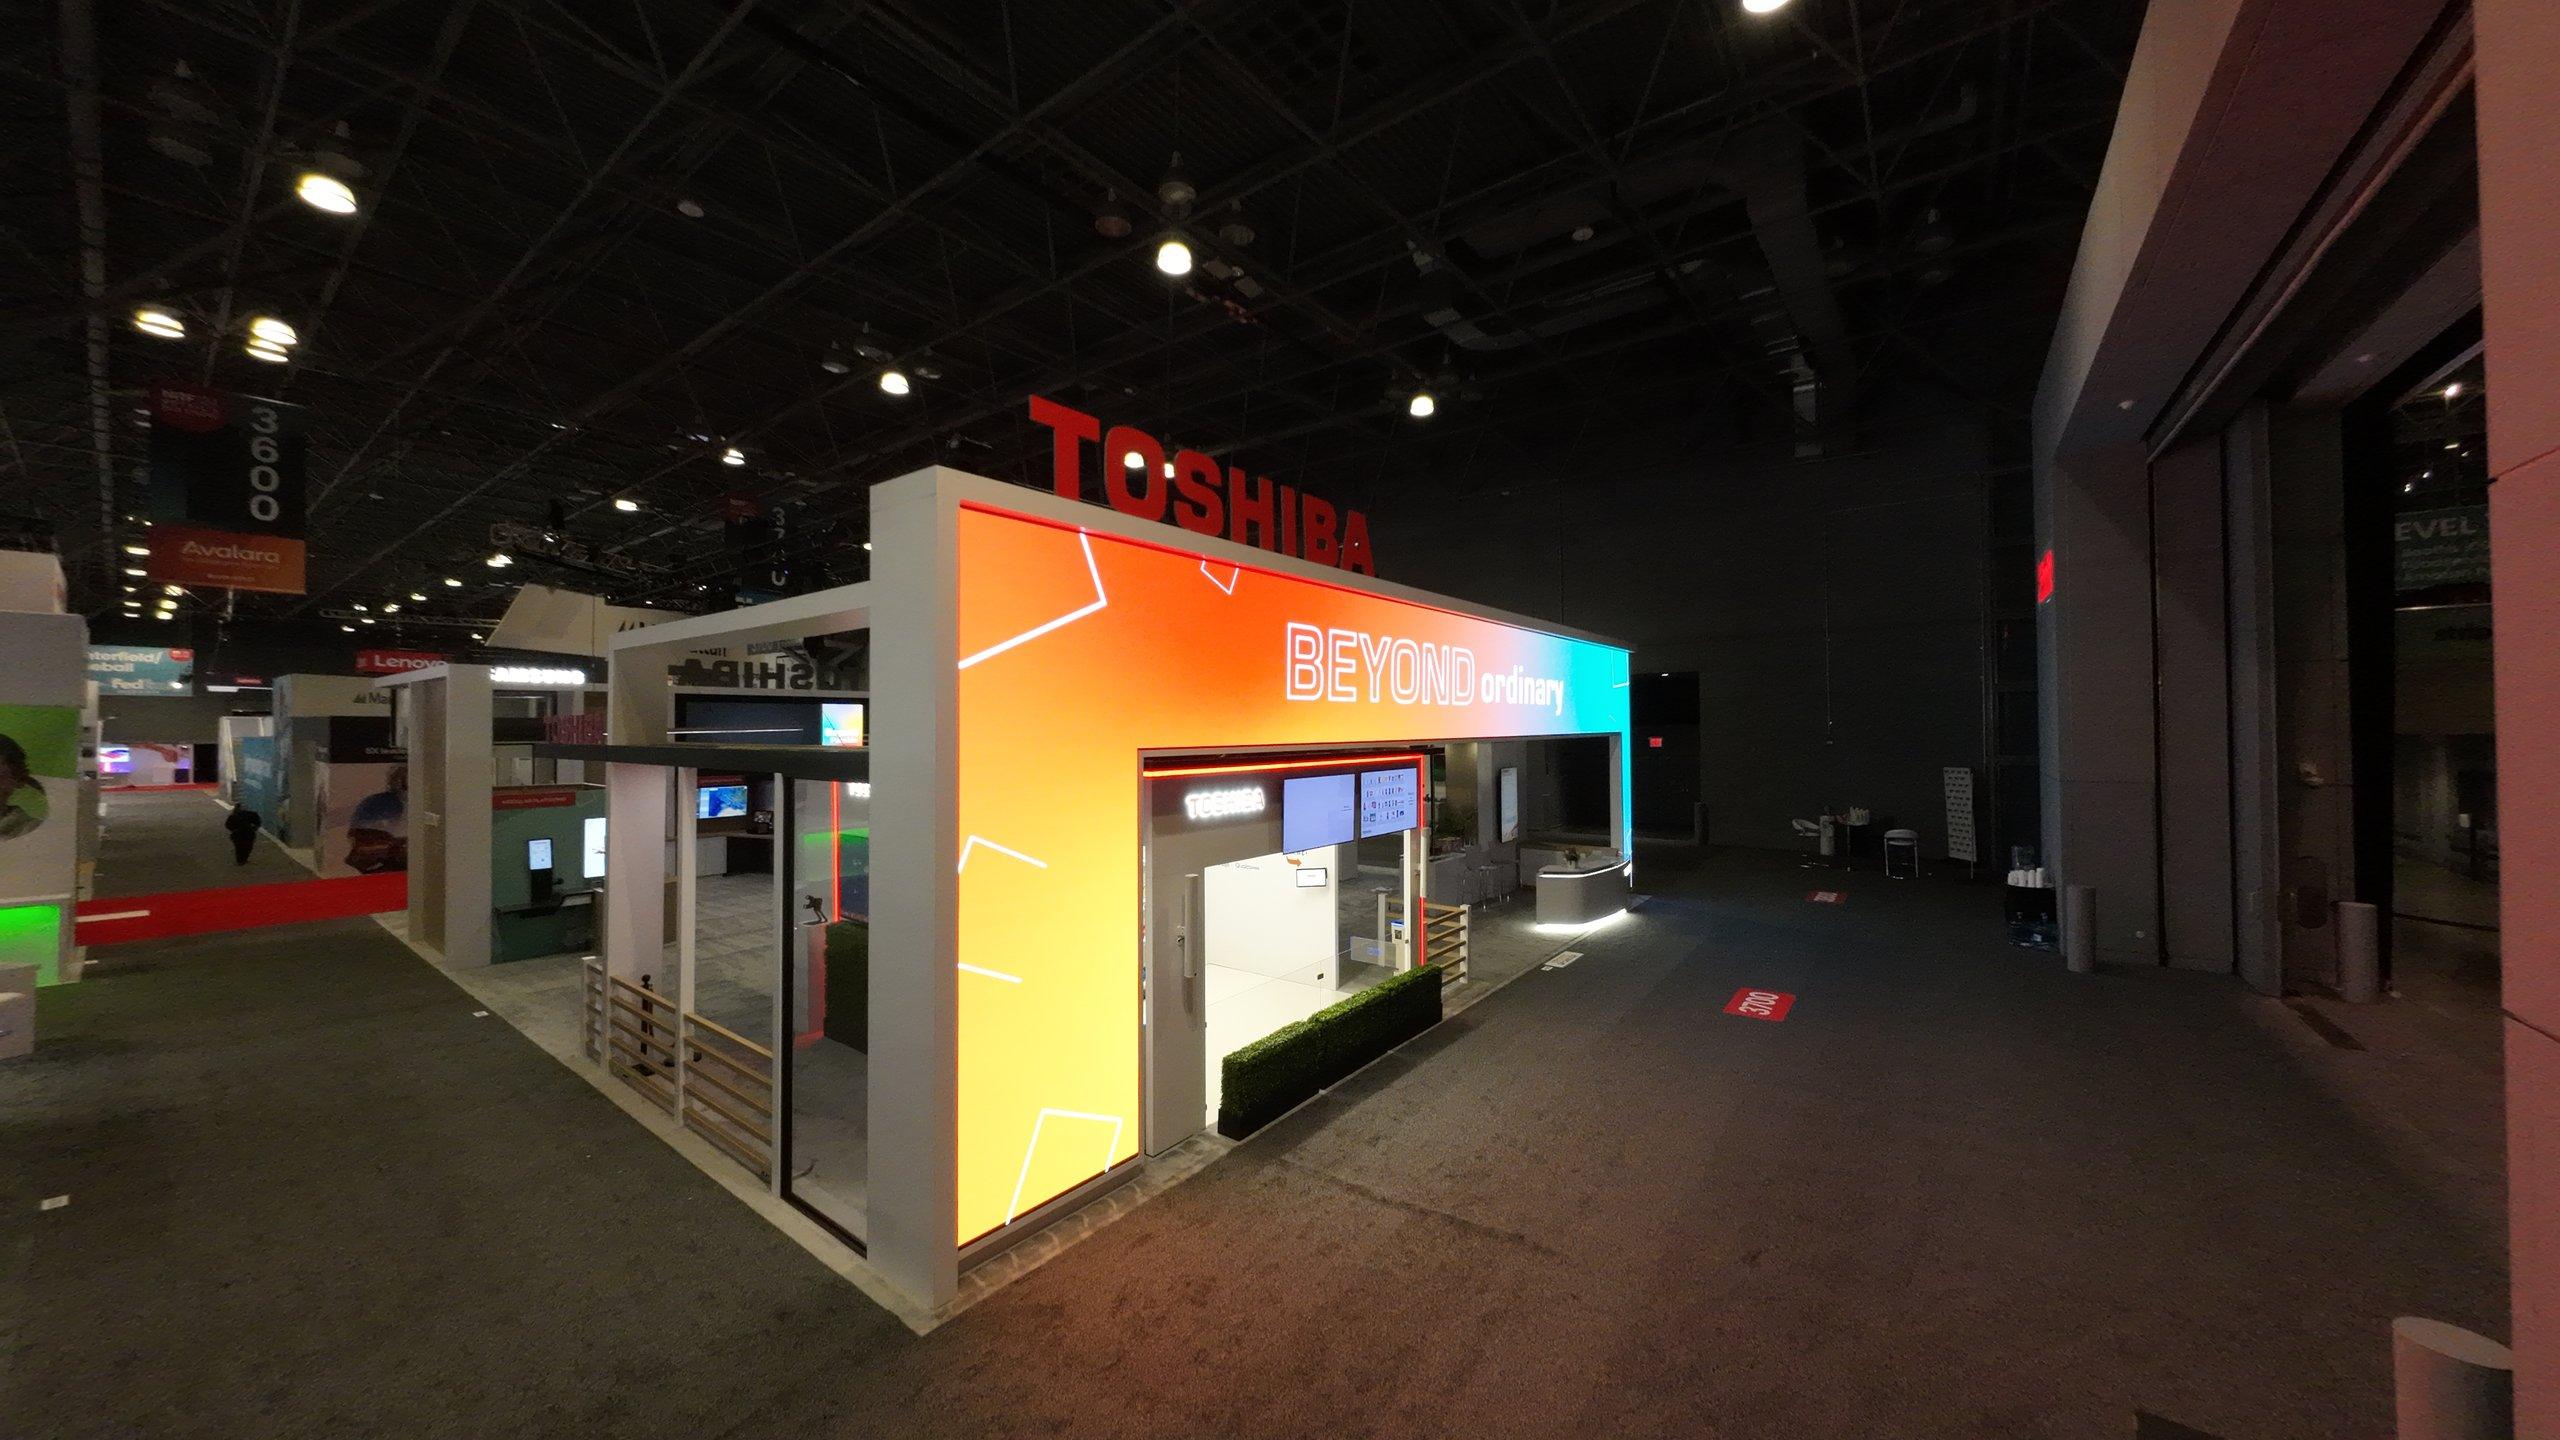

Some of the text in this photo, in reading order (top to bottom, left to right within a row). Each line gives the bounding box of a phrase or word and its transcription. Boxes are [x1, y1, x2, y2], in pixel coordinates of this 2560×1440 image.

[249, 406, 280, 522] 3600
[1029, 394, 1376, 577] TOSHIBA
[181, 540, 281, 564] Avalara
[373, 654, 449, 669] Lenovo
[1286, 621, 1564, 717] BEYOND ordinary
[1738, 991, 1779, 1016] 3700
